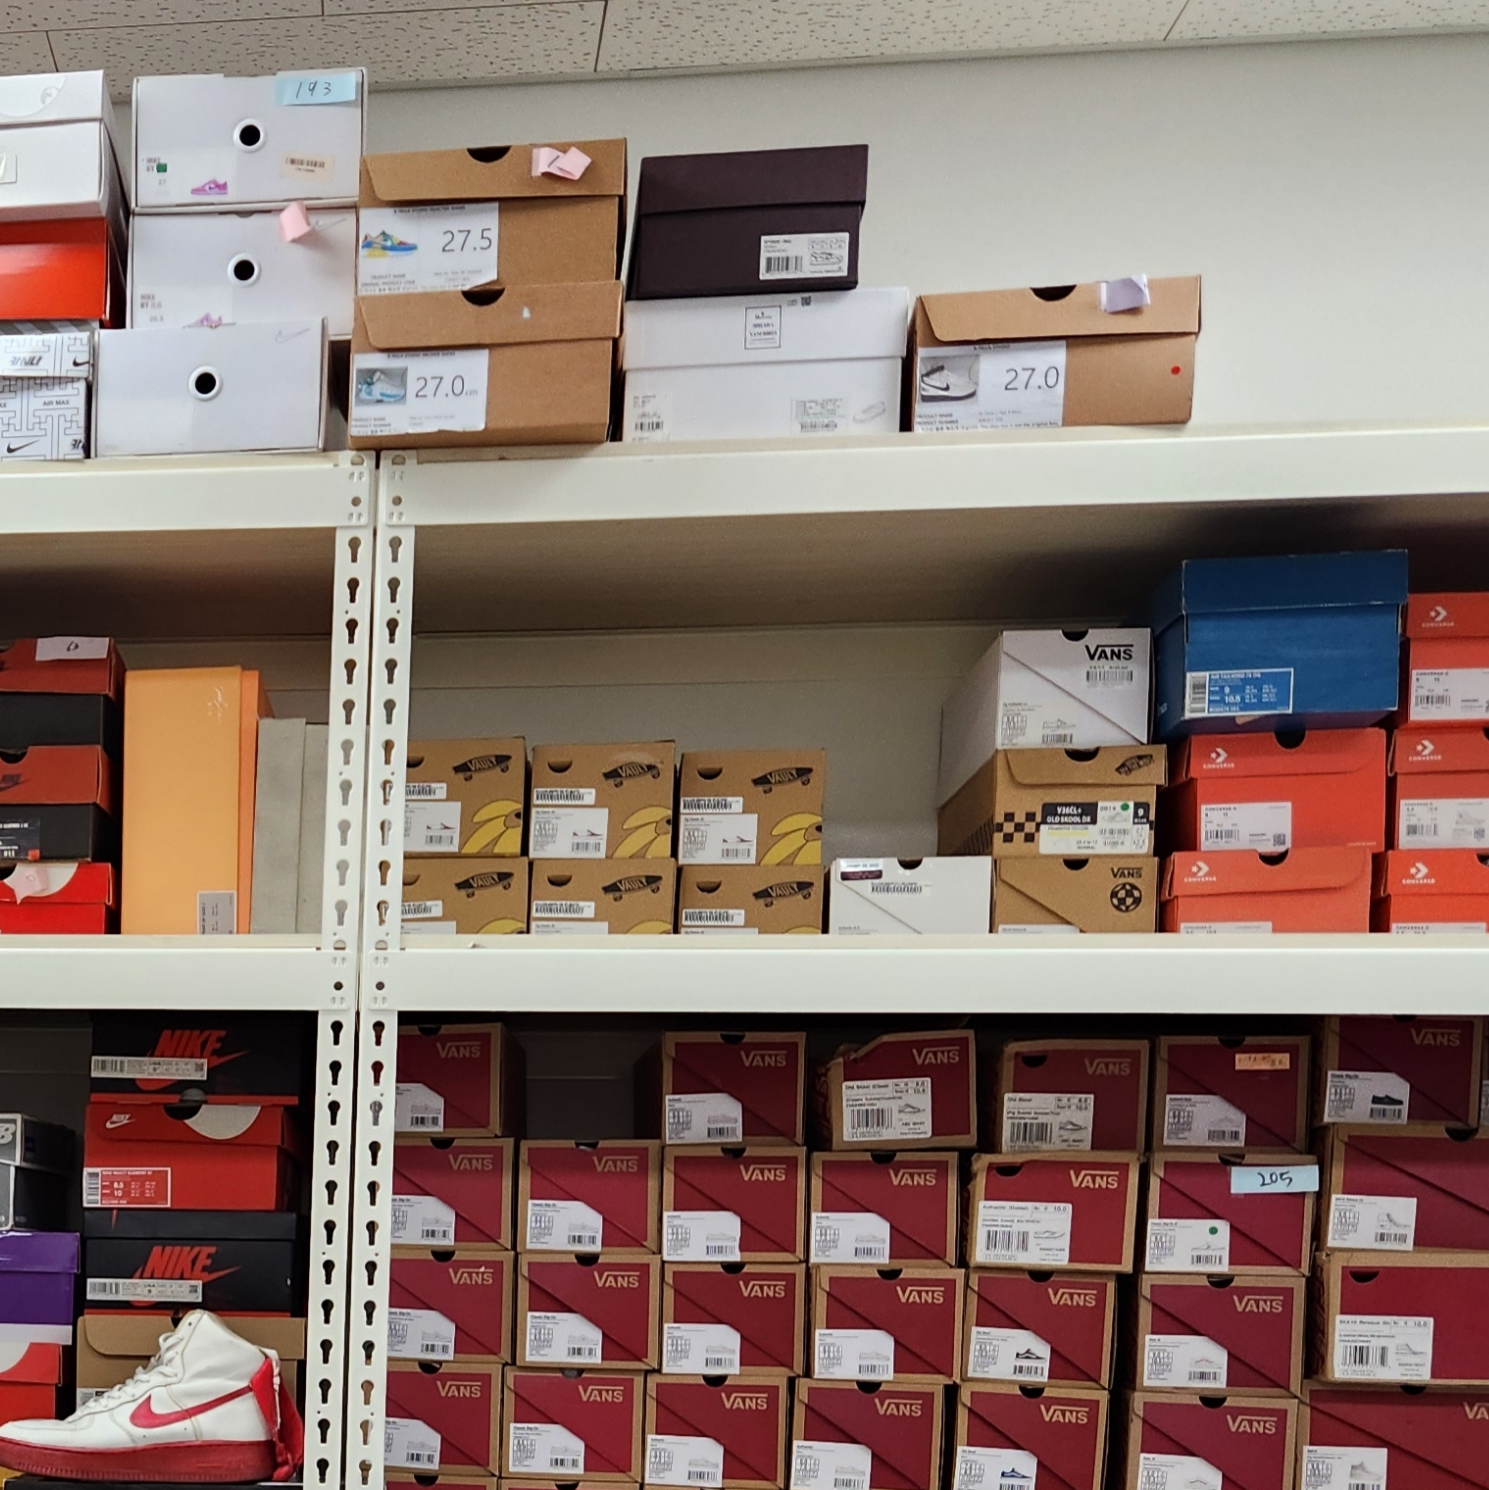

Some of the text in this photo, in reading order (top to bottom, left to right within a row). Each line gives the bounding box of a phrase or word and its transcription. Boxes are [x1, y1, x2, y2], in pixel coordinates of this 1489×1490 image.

[295, 81, 333, 99] 193
[441, 227, 492, 254] 27.5
[1004, 366, 1059, 392] 27.0
[1085, 644, 1134, 661] VANS
[467, 756, 499, 772] VAULT
[617, 764, 649, 780] VAULT
[767, 771, 799, 786] VAULT
[1138, 808, 1144, 816] 9
[469, 874, 502, 890] VAULT
[1110, 867, 1143, 880] VANS
[617, 879, 650, 895] VAULT
[768, 884, 800, 900] VAULT
[154, 1029, 226, 1059] NIKE
[1410, 1028, 1461, 1047] VANS
[436, 1041, 481, 1058] VANS
[912, 1046, 960, 1065] VANS
[741, 1050, 787, 1068] VANS
[1084, 1058, 1132, 1076] VANS
[448, 1154, 494, 1171] VANS
[592, 1155, 639, 1172] VANS
[740, 1164, 786, 1182] VANS
[888, 1168, 937, 1187] VANS
[1069, 1170, 1120, 1189] VANS
[1257, 1172, 1293, 1188] 205
[142, 1246, 217, 1279] NIKE
[448, 1268, 494, 1285] VANS
[593, 1271, 640, 1288] VANS
[739, 1281, 786, 1298] VANS
[896, 1286, 945, 1304] VANS
[1047, 1288, 1097, 1307] VANS
[1232, 1295, 1284, 1313] VANS
[436, 1381, 482, 1398] VANS
[578, 1386, 624, 1402] VANS
[721, 1393, 768, 1410] VANS
[874, 1399, 923, 1417] VANS
[1039, 1404, 1089, 1424] VANS
[1226, 1415, 1278, 1434] VANS
